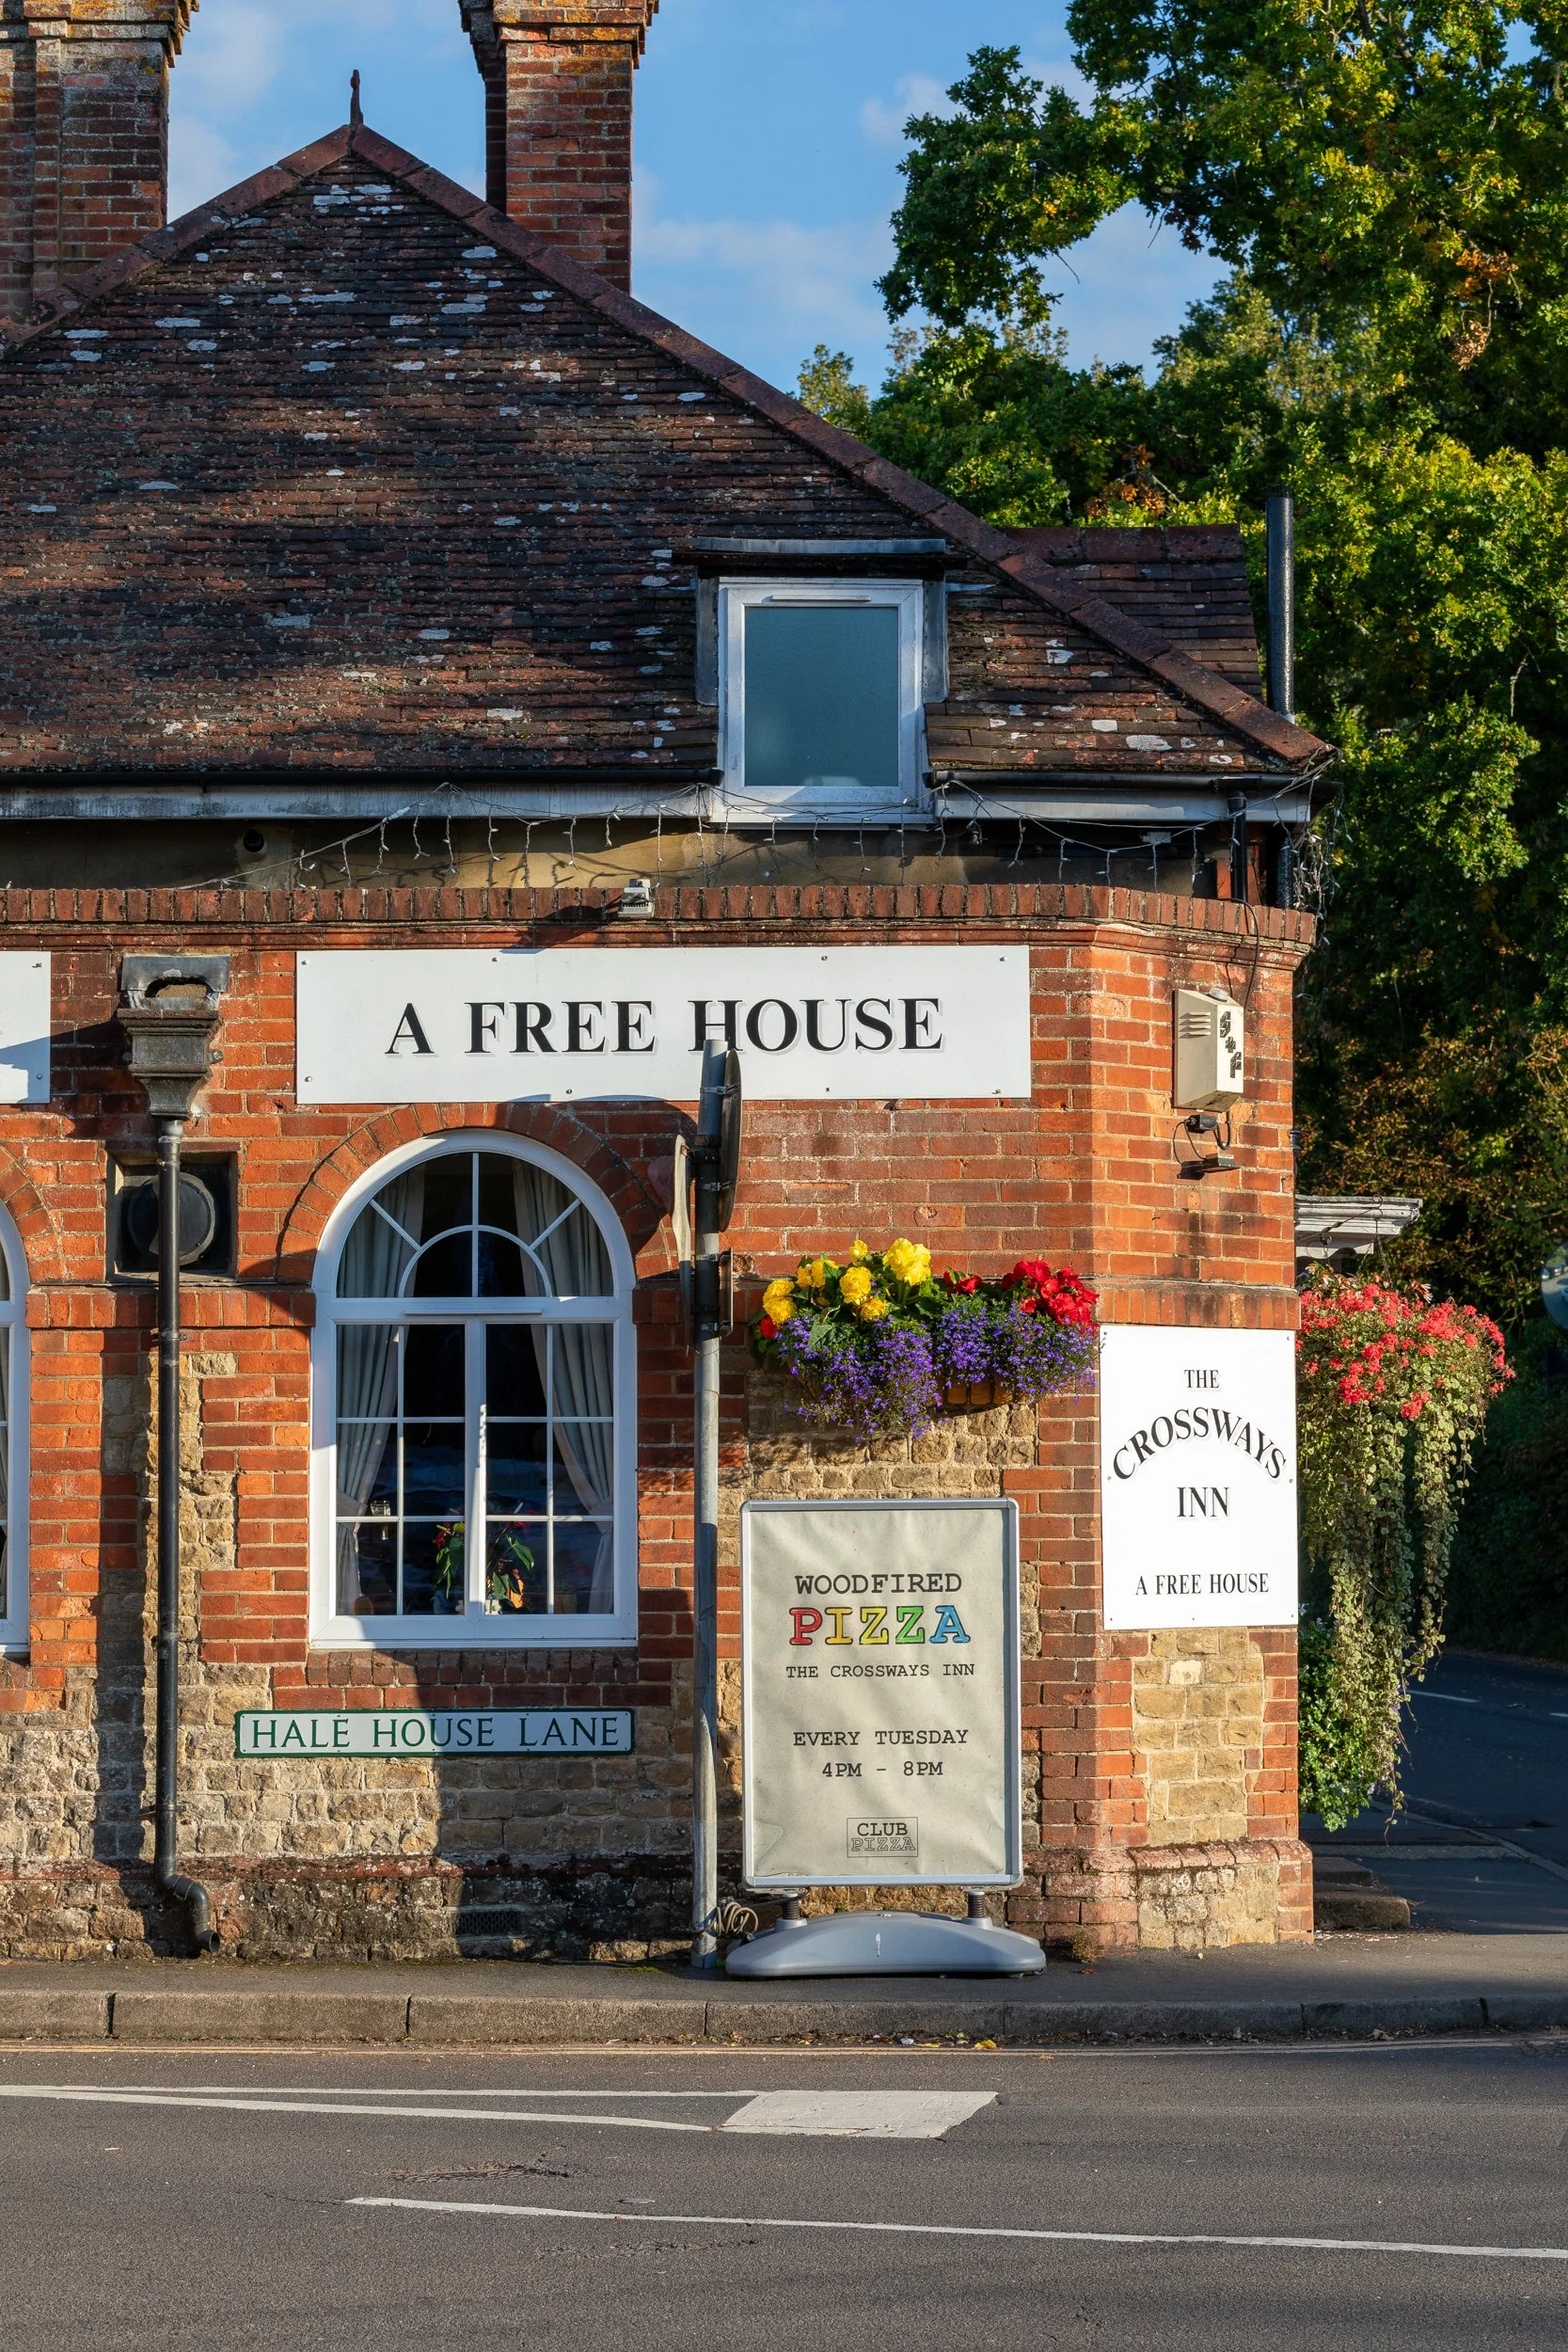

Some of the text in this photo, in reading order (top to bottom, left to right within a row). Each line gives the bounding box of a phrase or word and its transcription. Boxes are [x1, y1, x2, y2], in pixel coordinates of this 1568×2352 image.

[384, 997, 943, 1055] A FREE HOUSE
[1183, 1369, 1220, 1390] THE
[1112, 1406, 1287, 1481] CROSSWAYS
[1176, 1486, 1230, 1518] INN
[794, 1573, 963, 1596] WOODFIRED
[1134, 1572, 1270, 1596] A FREE HOUSE
[787, 1604, 973, 1646] PIZZA
[785, 1663, 975, 1679] THE CROSSWAYS INN
[251, 1716, 619, 1748] HALE HOUSE LANE
[792, 1729, 970, 1747] EVERY TUESDAY
[821, 1761, 863, 1778] 4PM
[902, 1760, 944, 1777] 8PM
[856, 1821, 909, 1837] CLUB
[850, 1836, 916, 1852] PIZZA
